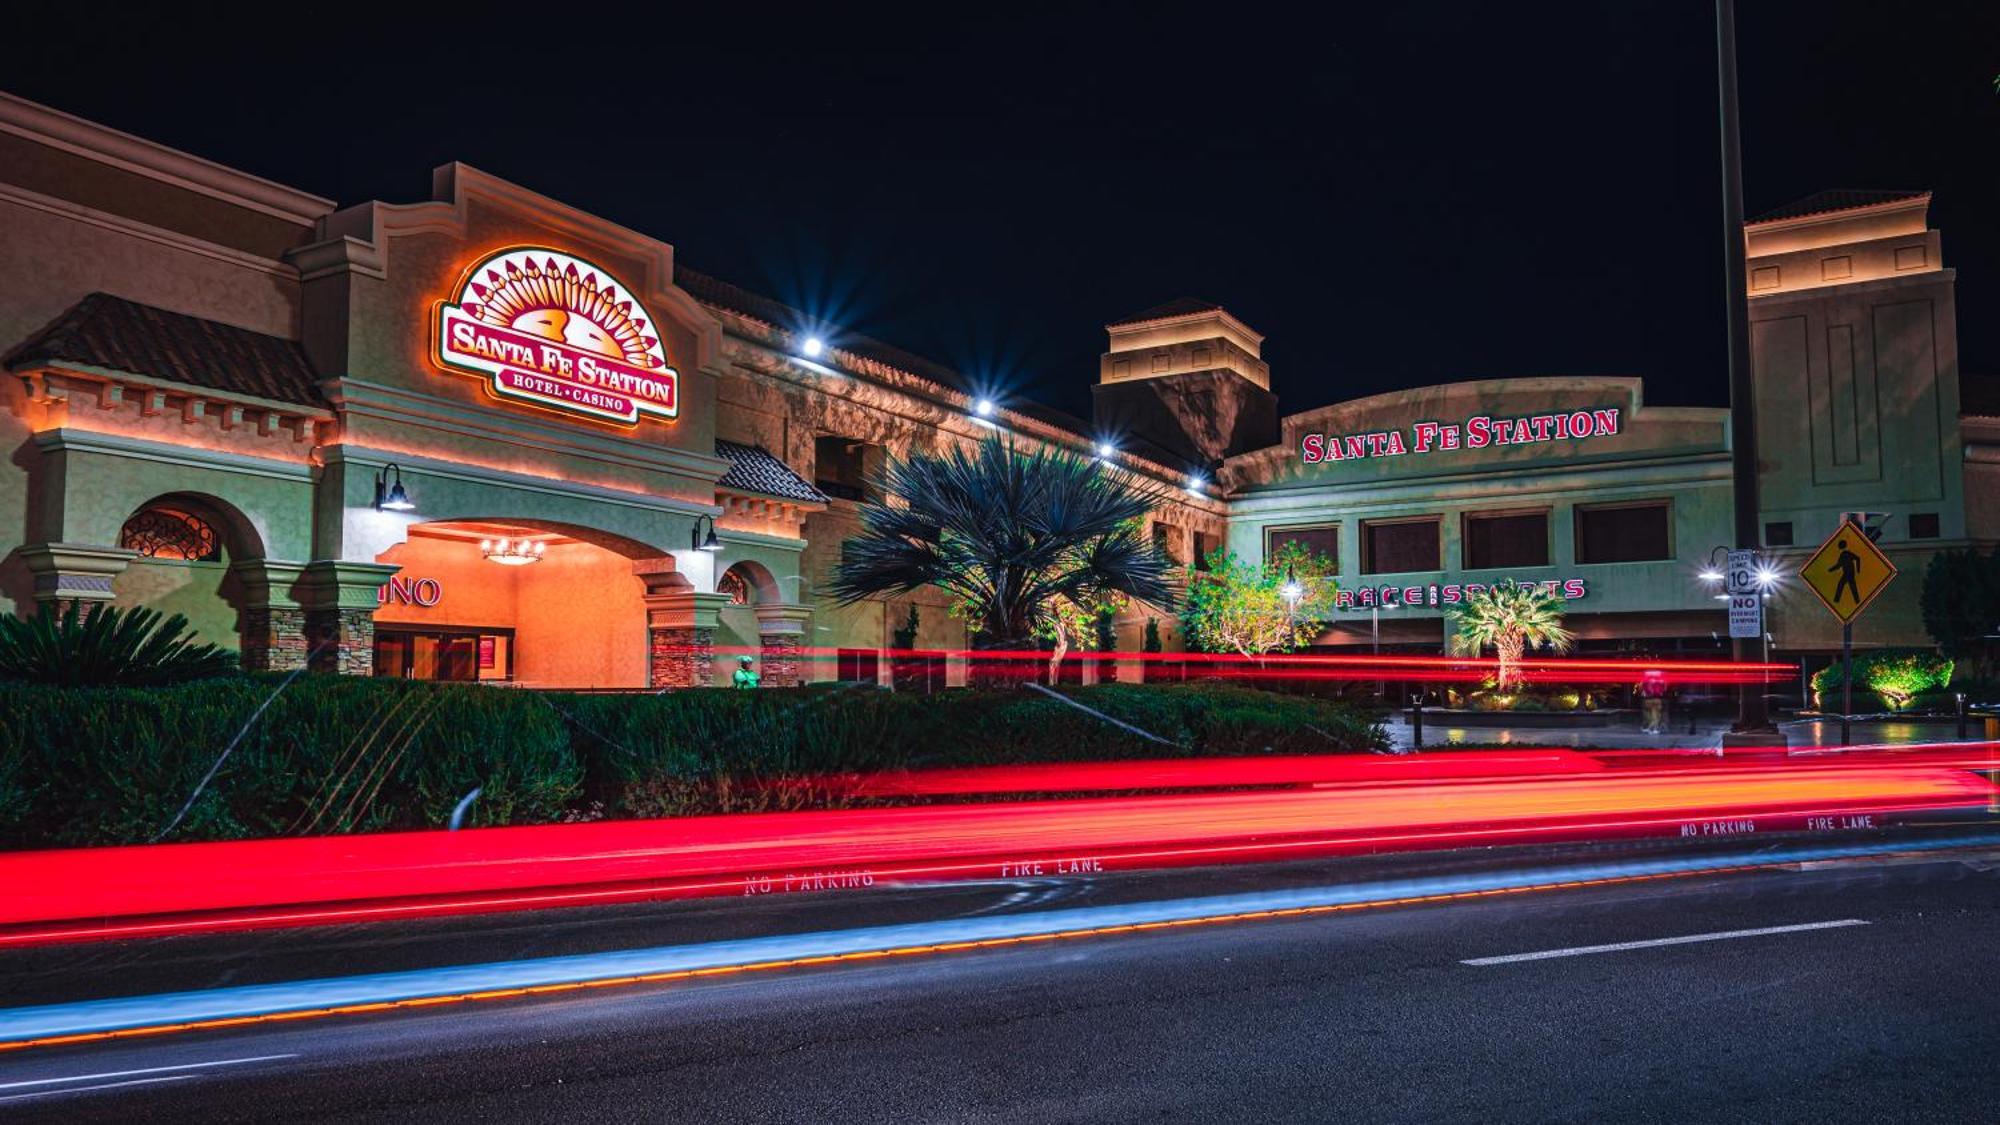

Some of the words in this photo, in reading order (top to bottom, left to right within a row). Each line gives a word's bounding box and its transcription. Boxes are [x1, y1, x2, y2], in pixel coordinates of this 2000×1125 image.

[453, 322, 535, 367] SANTA
[541, 346, 573, 377] FE
[578, 357, 670, 402] STATION
[513, 375, 563, 396] HOTEL
[572, 390, 624, 411] CASINO
[1303, 432, 1407, 464] SANTA
[1414, 422, 1460, 453] FE
[1467, 409, 1618, 448] STATION
[1731, 570, 1749, 587] 10
[1335, 585, 1423, 607] RACE
[1733, 598, 1755, 609] NO
[1681, 823, 1697, 837] NO
[1703, 820, 1754, 836] PARKING
[1807, 816, 1835, 831] FIRE
[1842, 815, 1873, 830] LANE
[1001, 860, 1043, 877] FIRE
[1057, 857, 1104, 874] LANE
[744, 876, 772, 897] NO
[785, 869, 873, 892] PARKING
